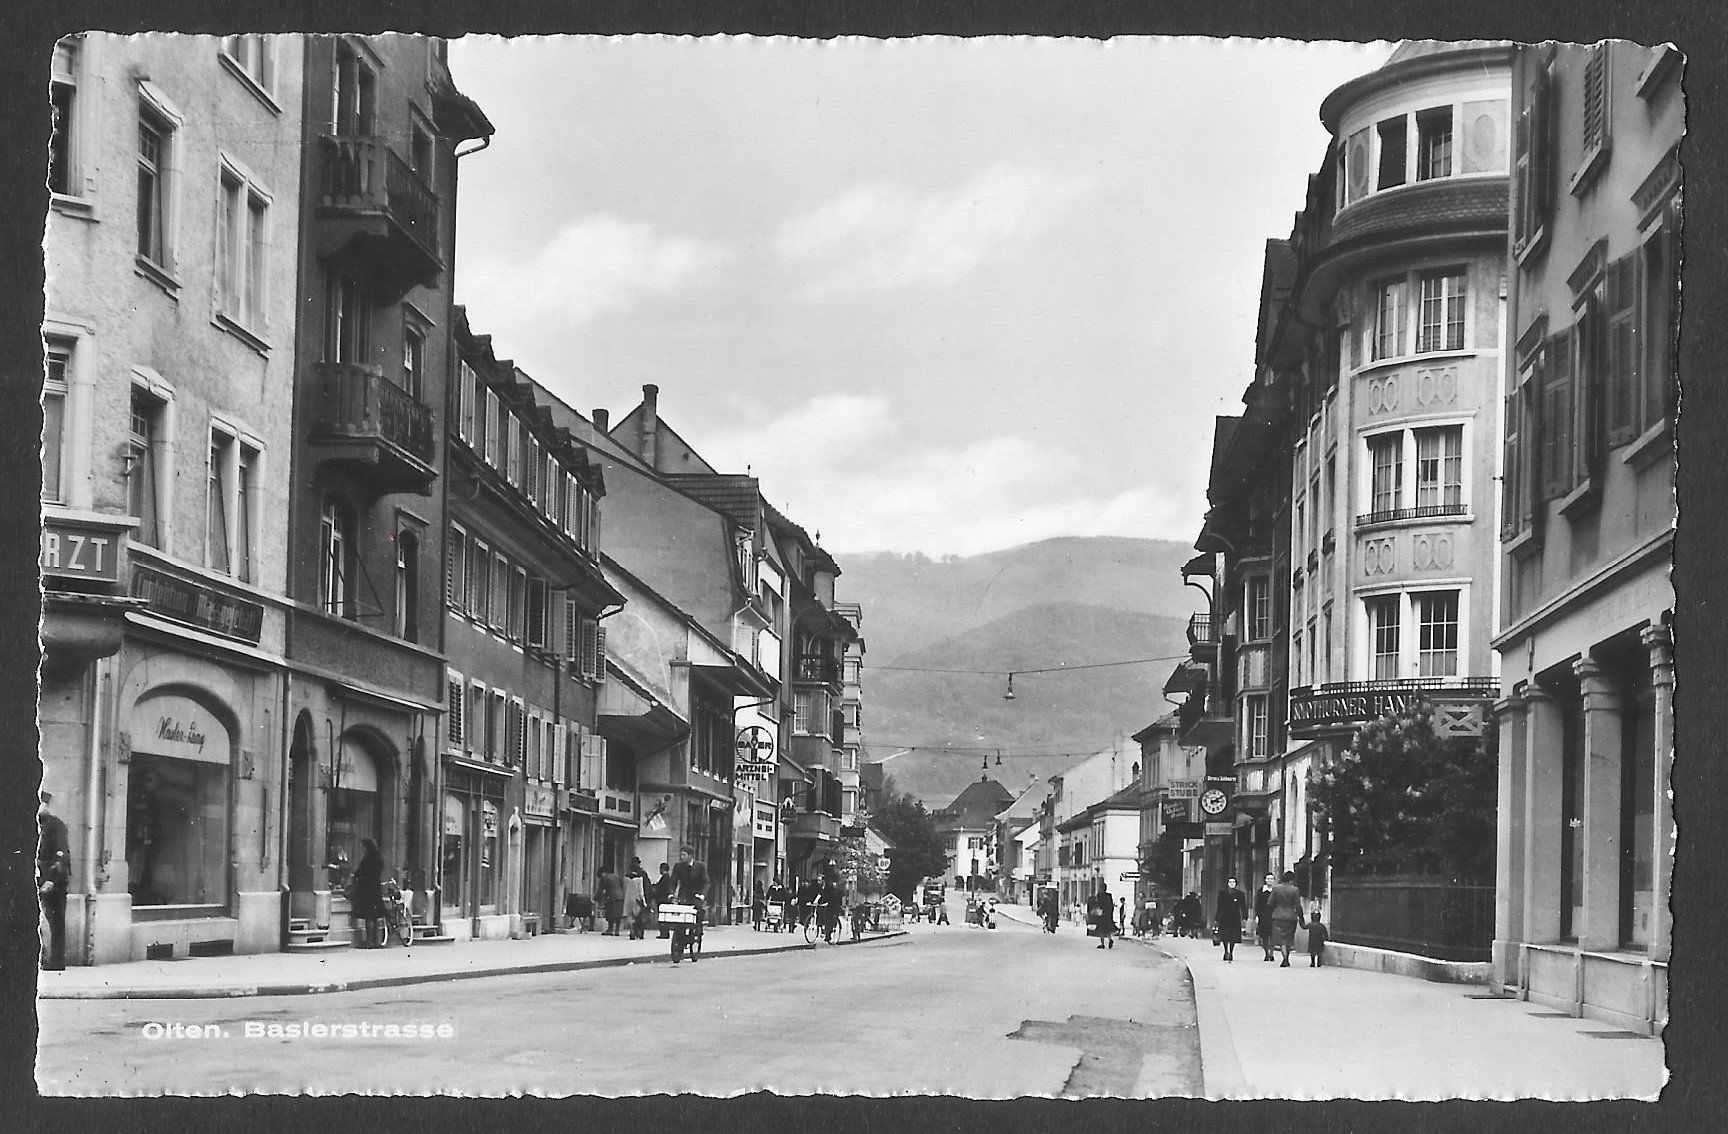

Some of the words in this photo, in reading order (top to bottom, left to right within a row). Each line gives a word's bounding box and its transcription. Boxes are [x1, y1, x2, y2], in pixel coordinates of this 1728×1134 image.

[735, 764, 773, 772] ARZNEI-
[735, 773, 767, 781] MITTEL
[1170, 781, 1198, 789] STRICK
